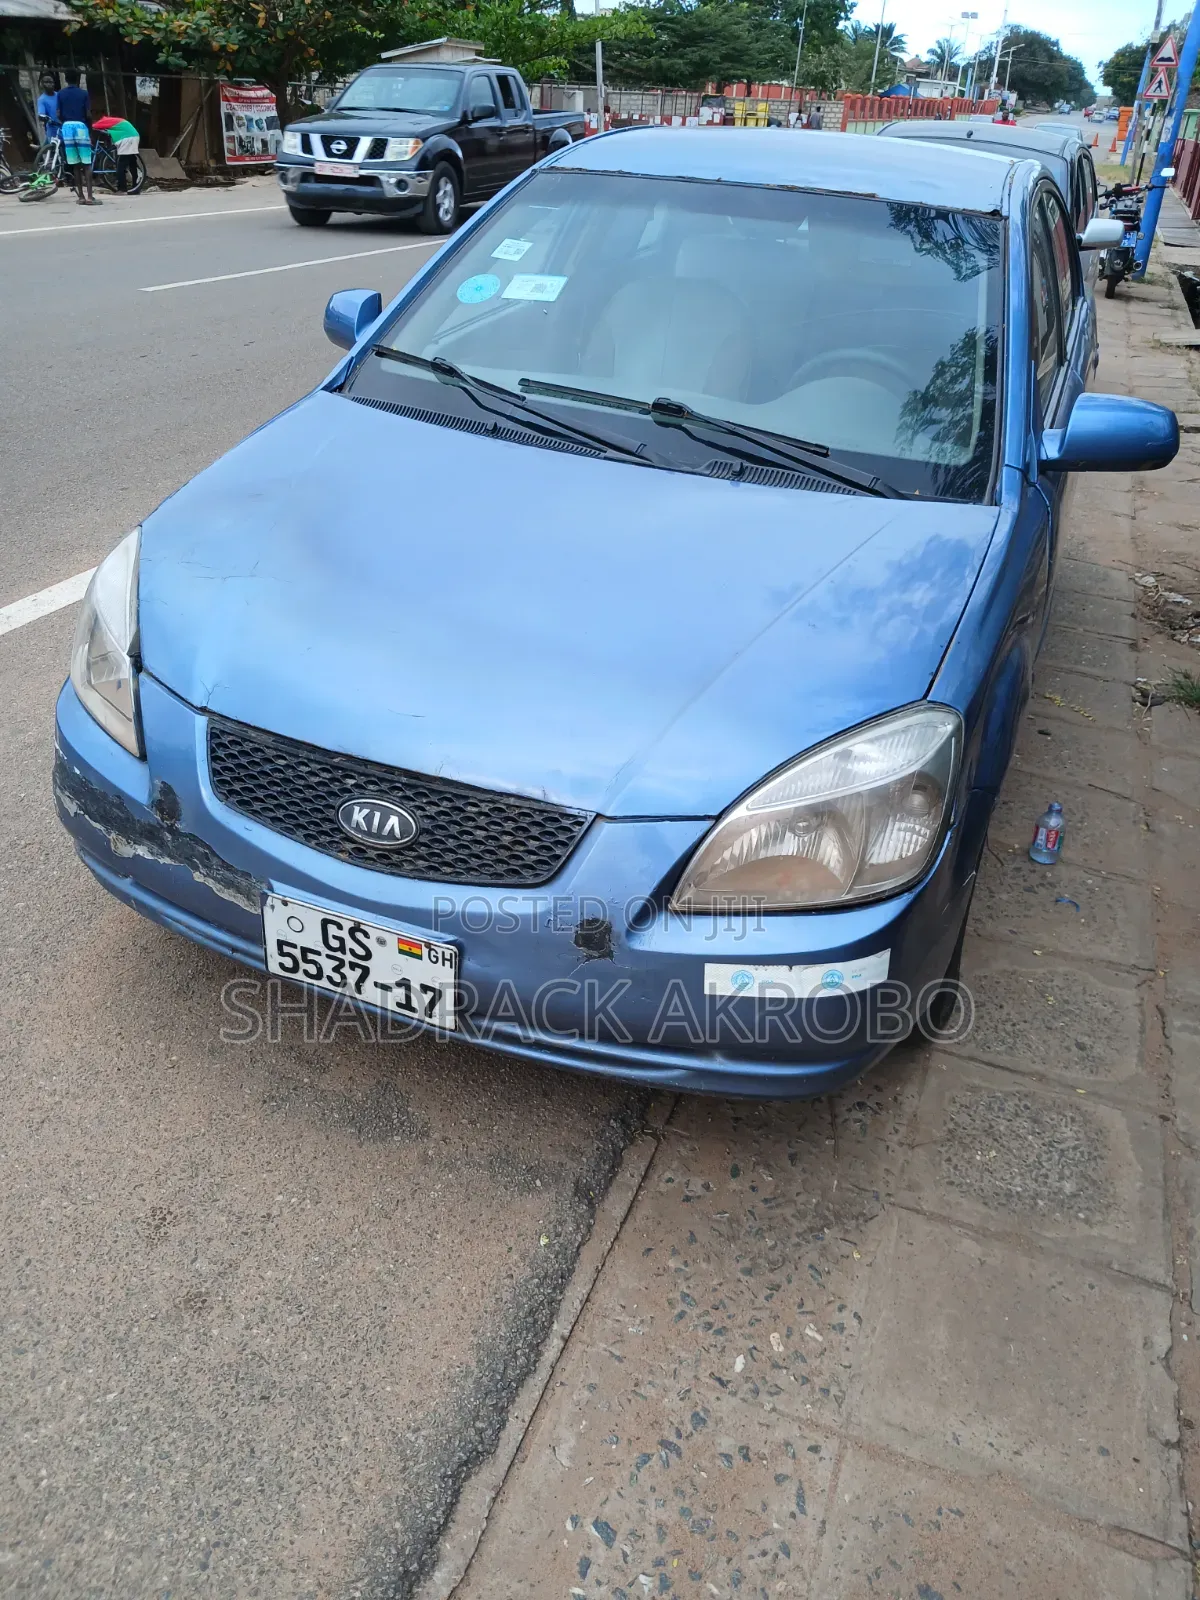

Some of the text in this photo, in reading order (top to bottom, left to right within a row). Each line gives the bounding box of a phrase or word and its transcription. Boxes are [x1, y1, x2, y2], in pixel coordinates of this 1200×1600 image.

[351, 805, 401, 839] KIA
[321, 918, 454, 969] GS GH
[276, 938, 443, 1019] 5537-17
